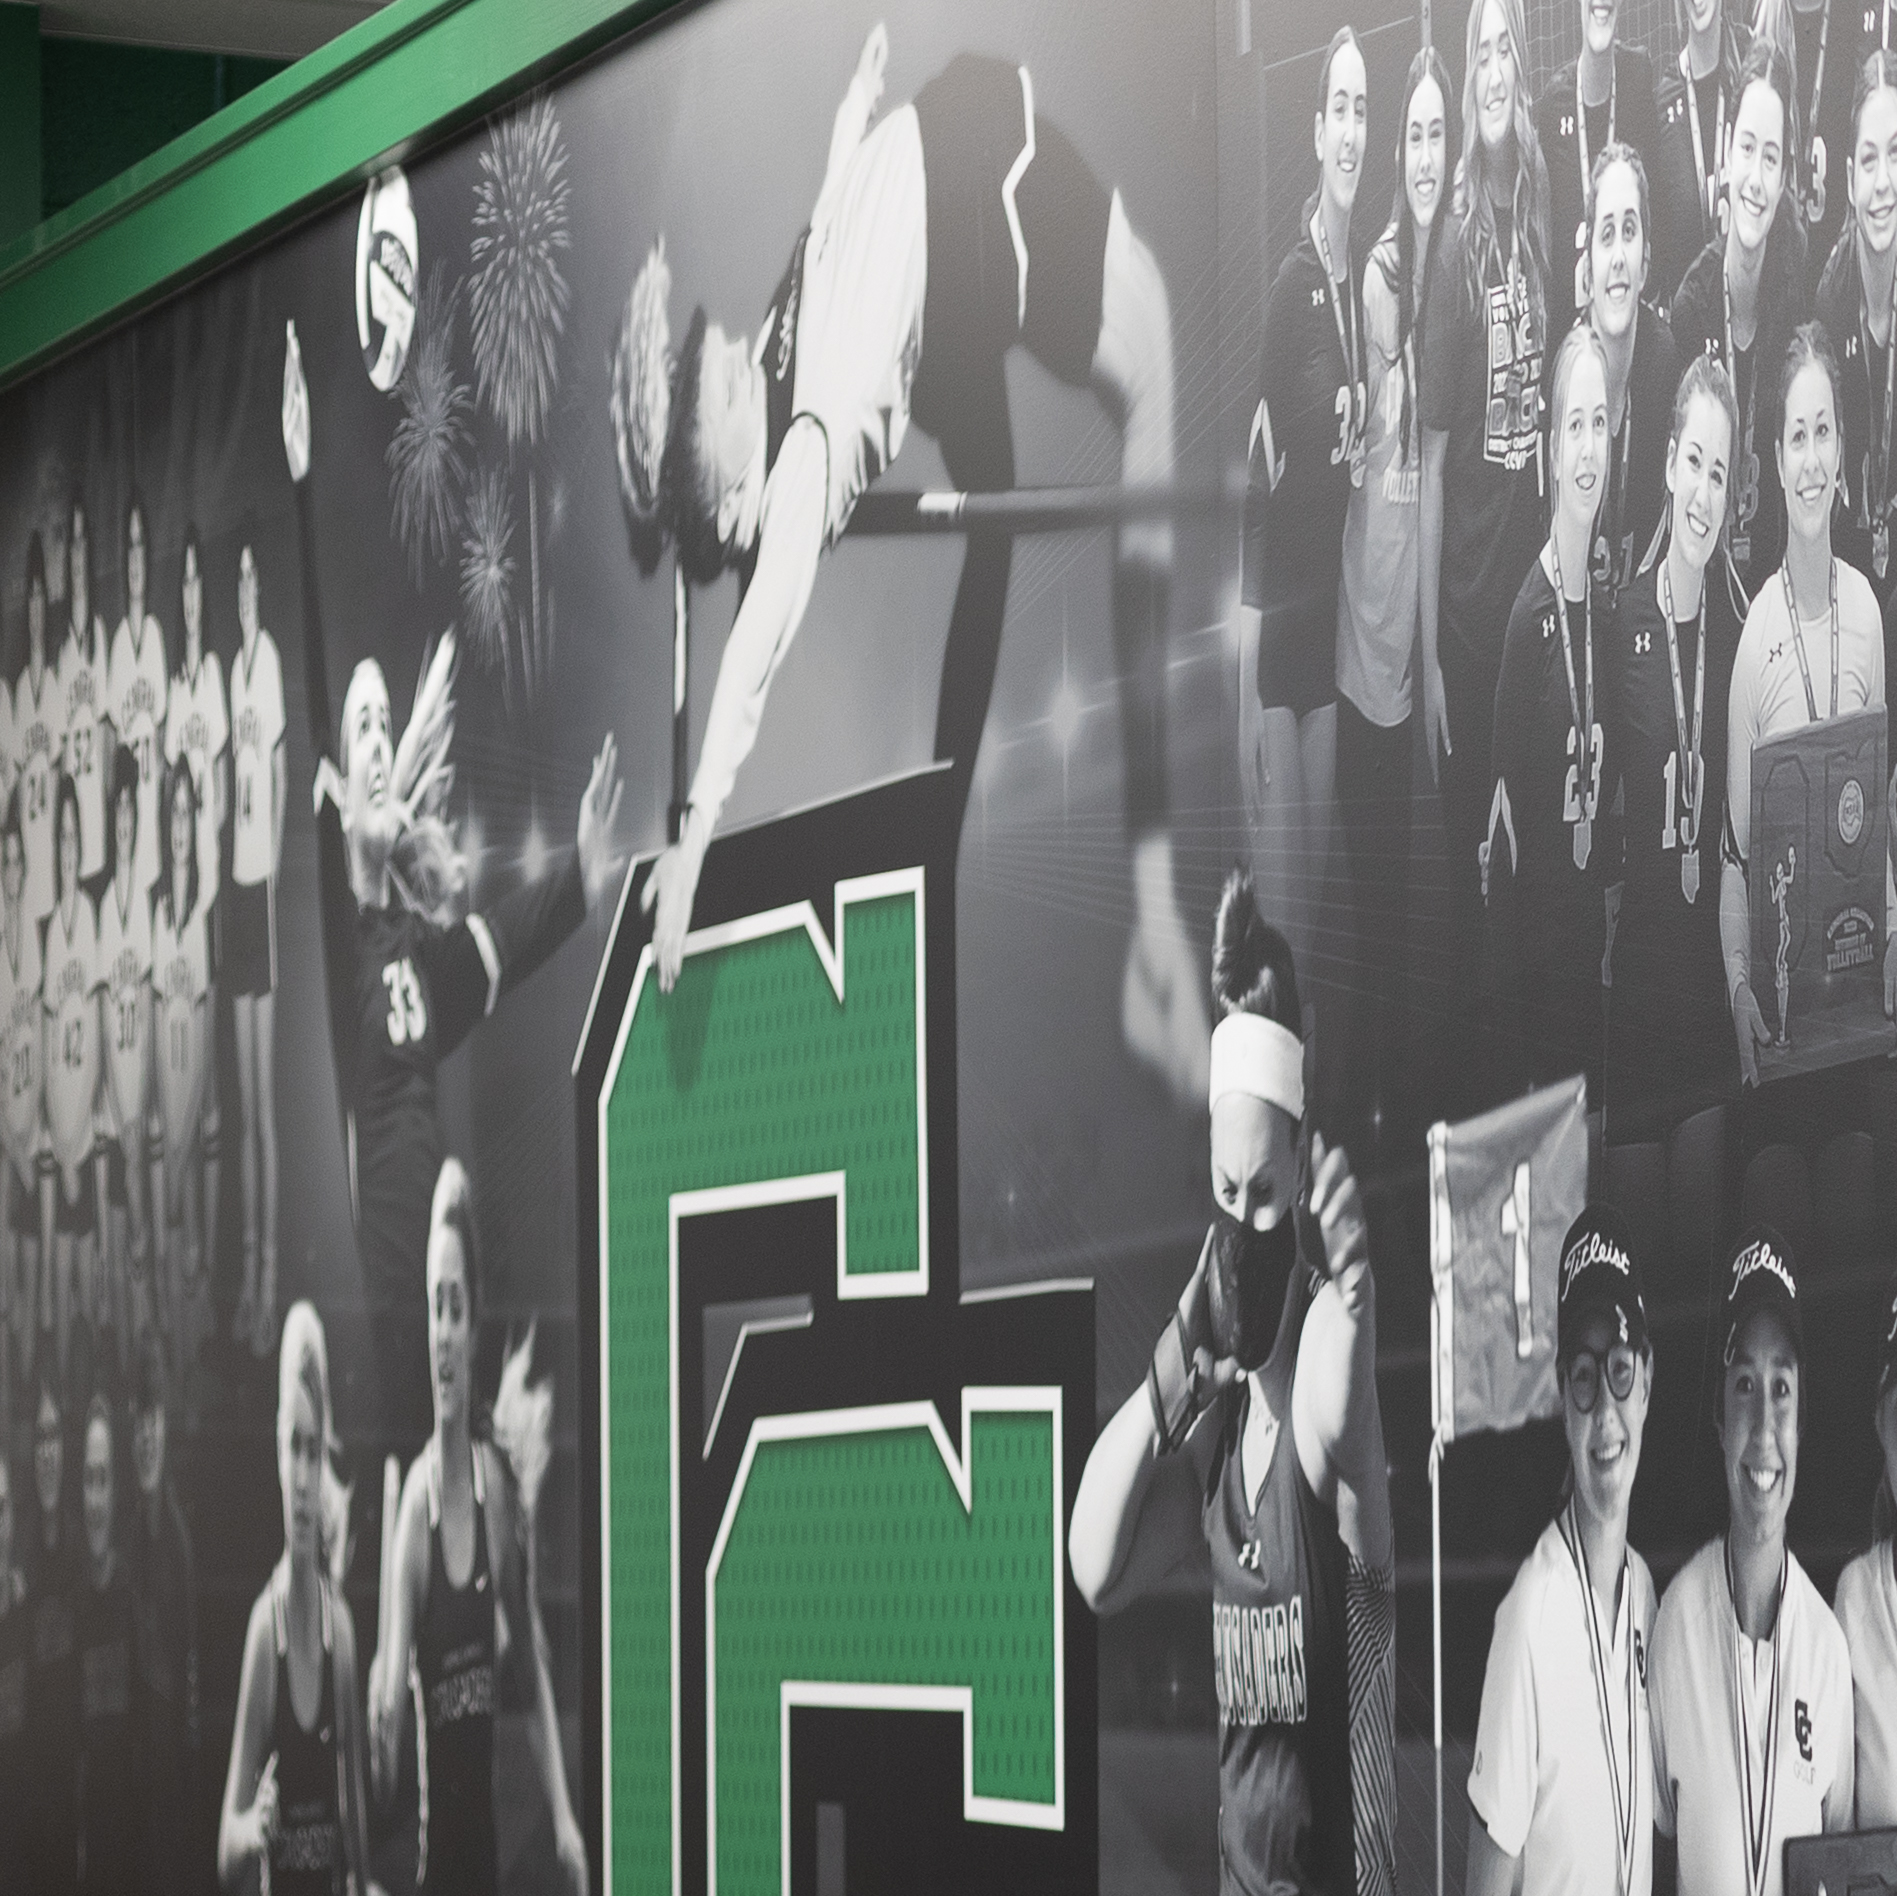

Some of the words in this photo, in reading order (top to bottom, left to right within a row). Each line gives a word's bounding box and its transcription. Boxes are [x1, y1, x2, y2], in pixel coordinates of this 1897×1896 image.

[381, 957, 427, 1046] 33
[1501, 1162, 1534, 1358] 1
[1561, 1231, 1631, 1302] Titleist
